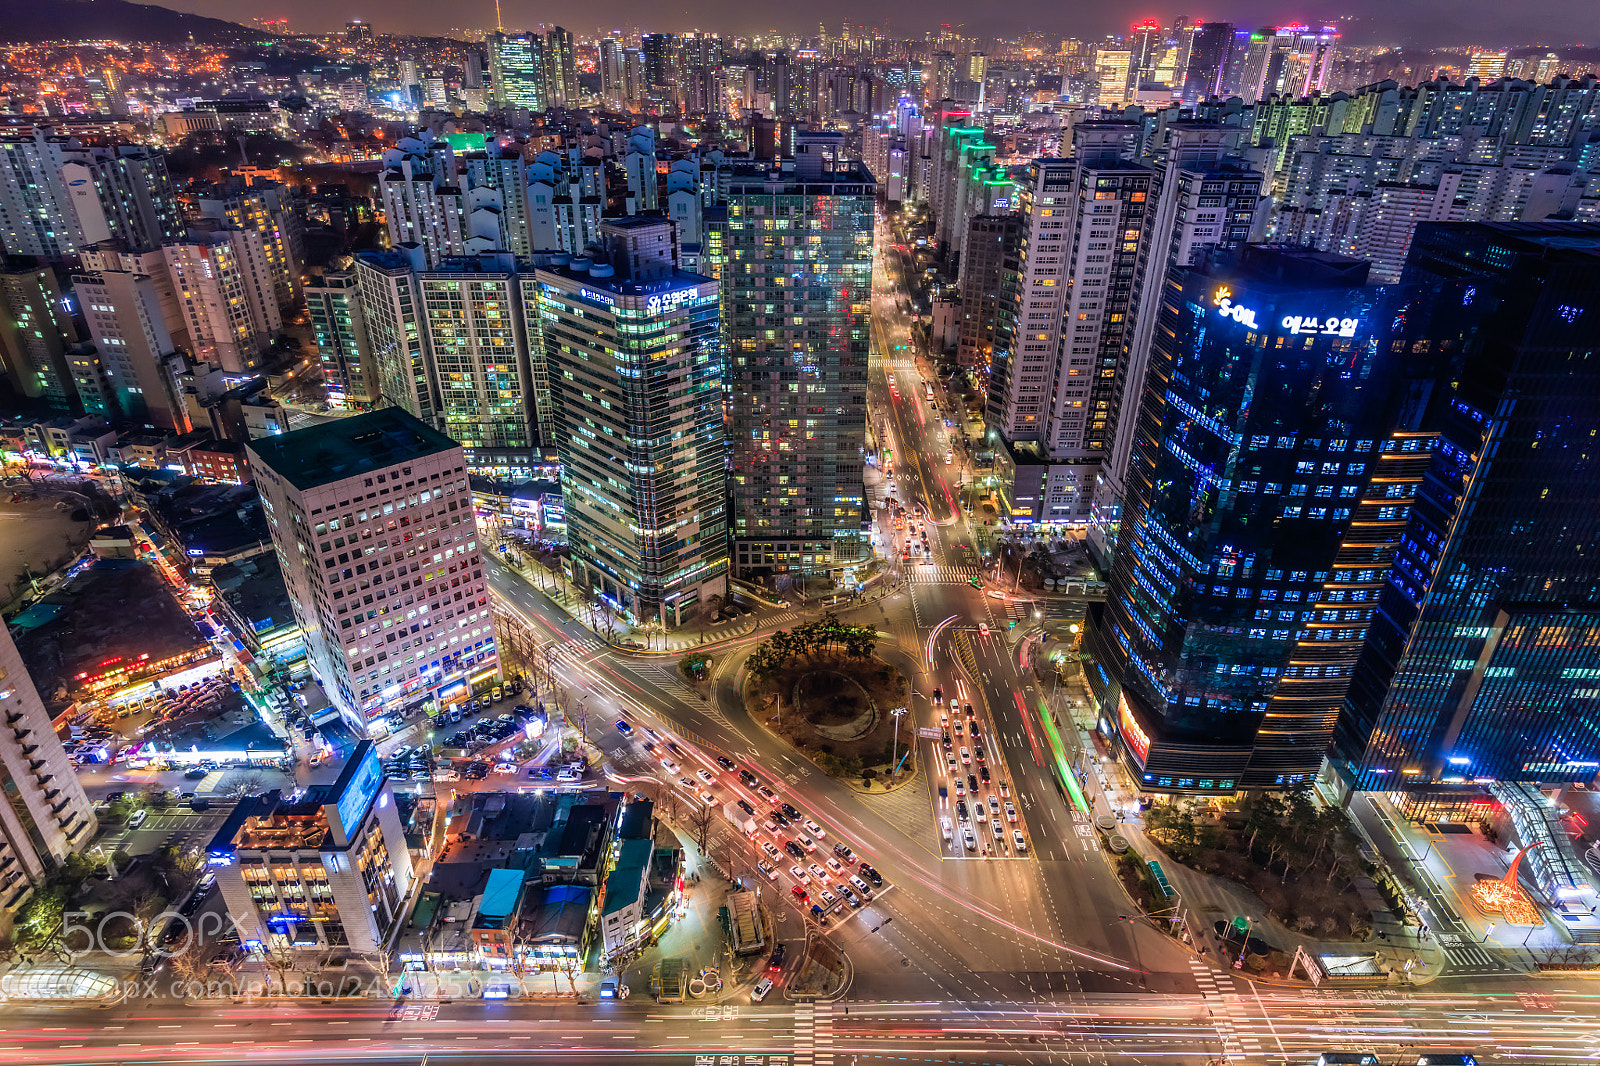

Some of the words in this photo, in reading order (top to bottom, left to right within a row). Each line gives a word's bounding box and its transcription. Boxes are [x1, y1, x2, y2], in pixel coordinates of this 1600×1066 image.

[662, 287, 698, 306] 수협은행
[1218, 298, 1258, 330] S-OIL
[1282, 315, 1359, 338] 에쓰-오일
